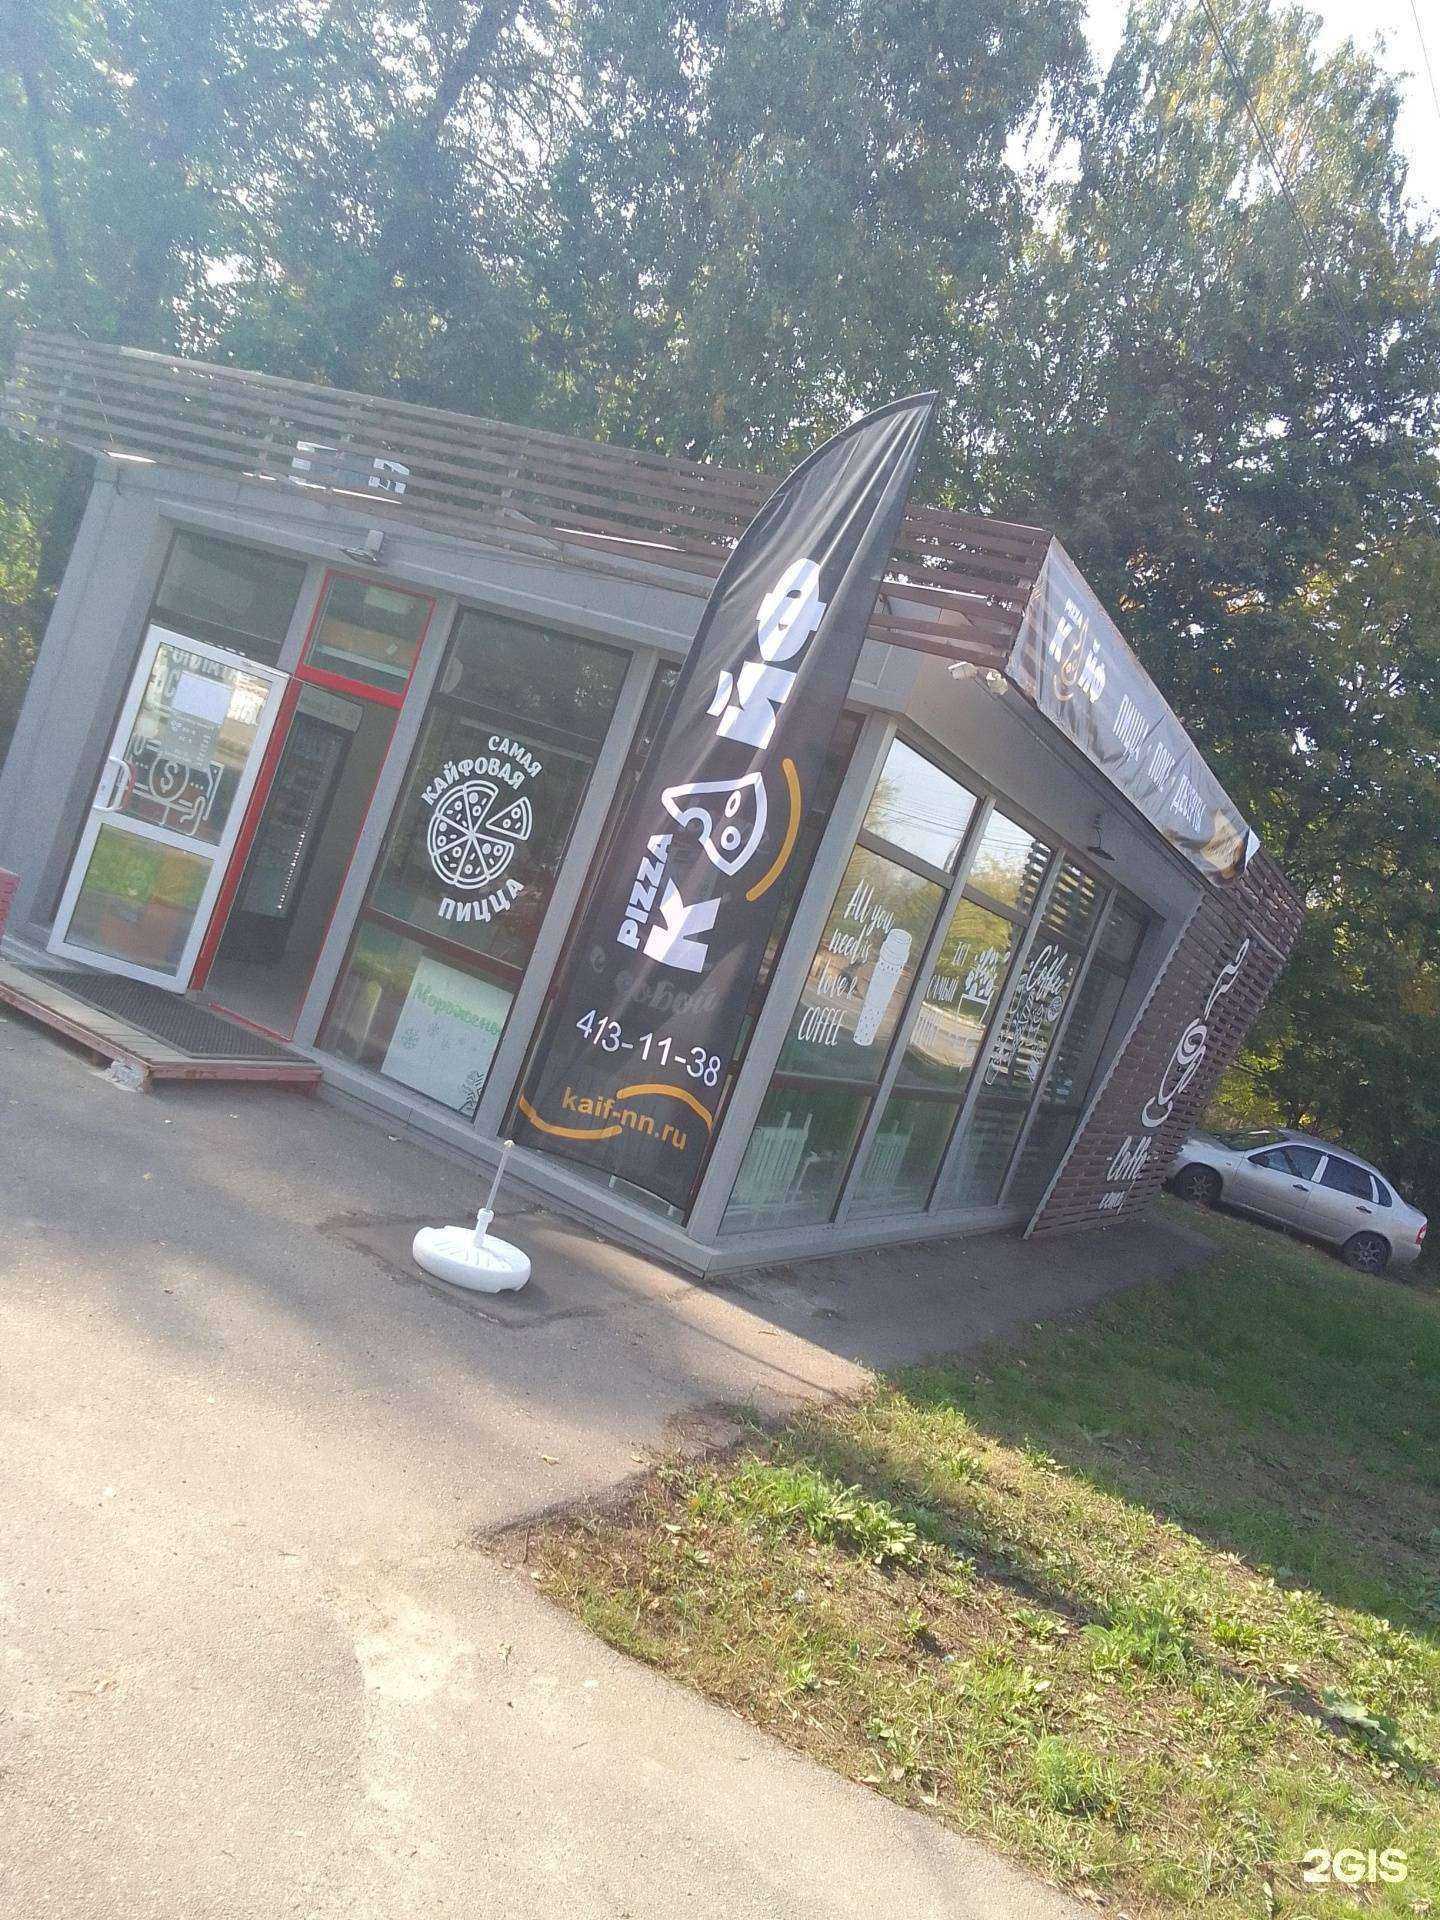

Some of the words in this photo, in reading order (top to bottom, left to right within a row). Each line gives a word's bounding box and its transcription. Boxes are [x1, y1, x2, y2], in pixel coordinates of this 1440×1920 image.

[488, 735, 543, 778] САМАЯ
[421, 757, 525, 806] КАЙФОВАЯ
[438, 878, 525, 923] ПИЦЦА
[617, 833, 673, 950] PIZZA
[843, 878, 876, 923] All
[867, 904, 895, 937] you
[828, 924, 868, 965] need
[576, 1009, 721, 1087] 413-11-38
[797, 1006, 848, 1047] COFFEE
[561, 1087, 687, 1150] kaif-nn.ru
